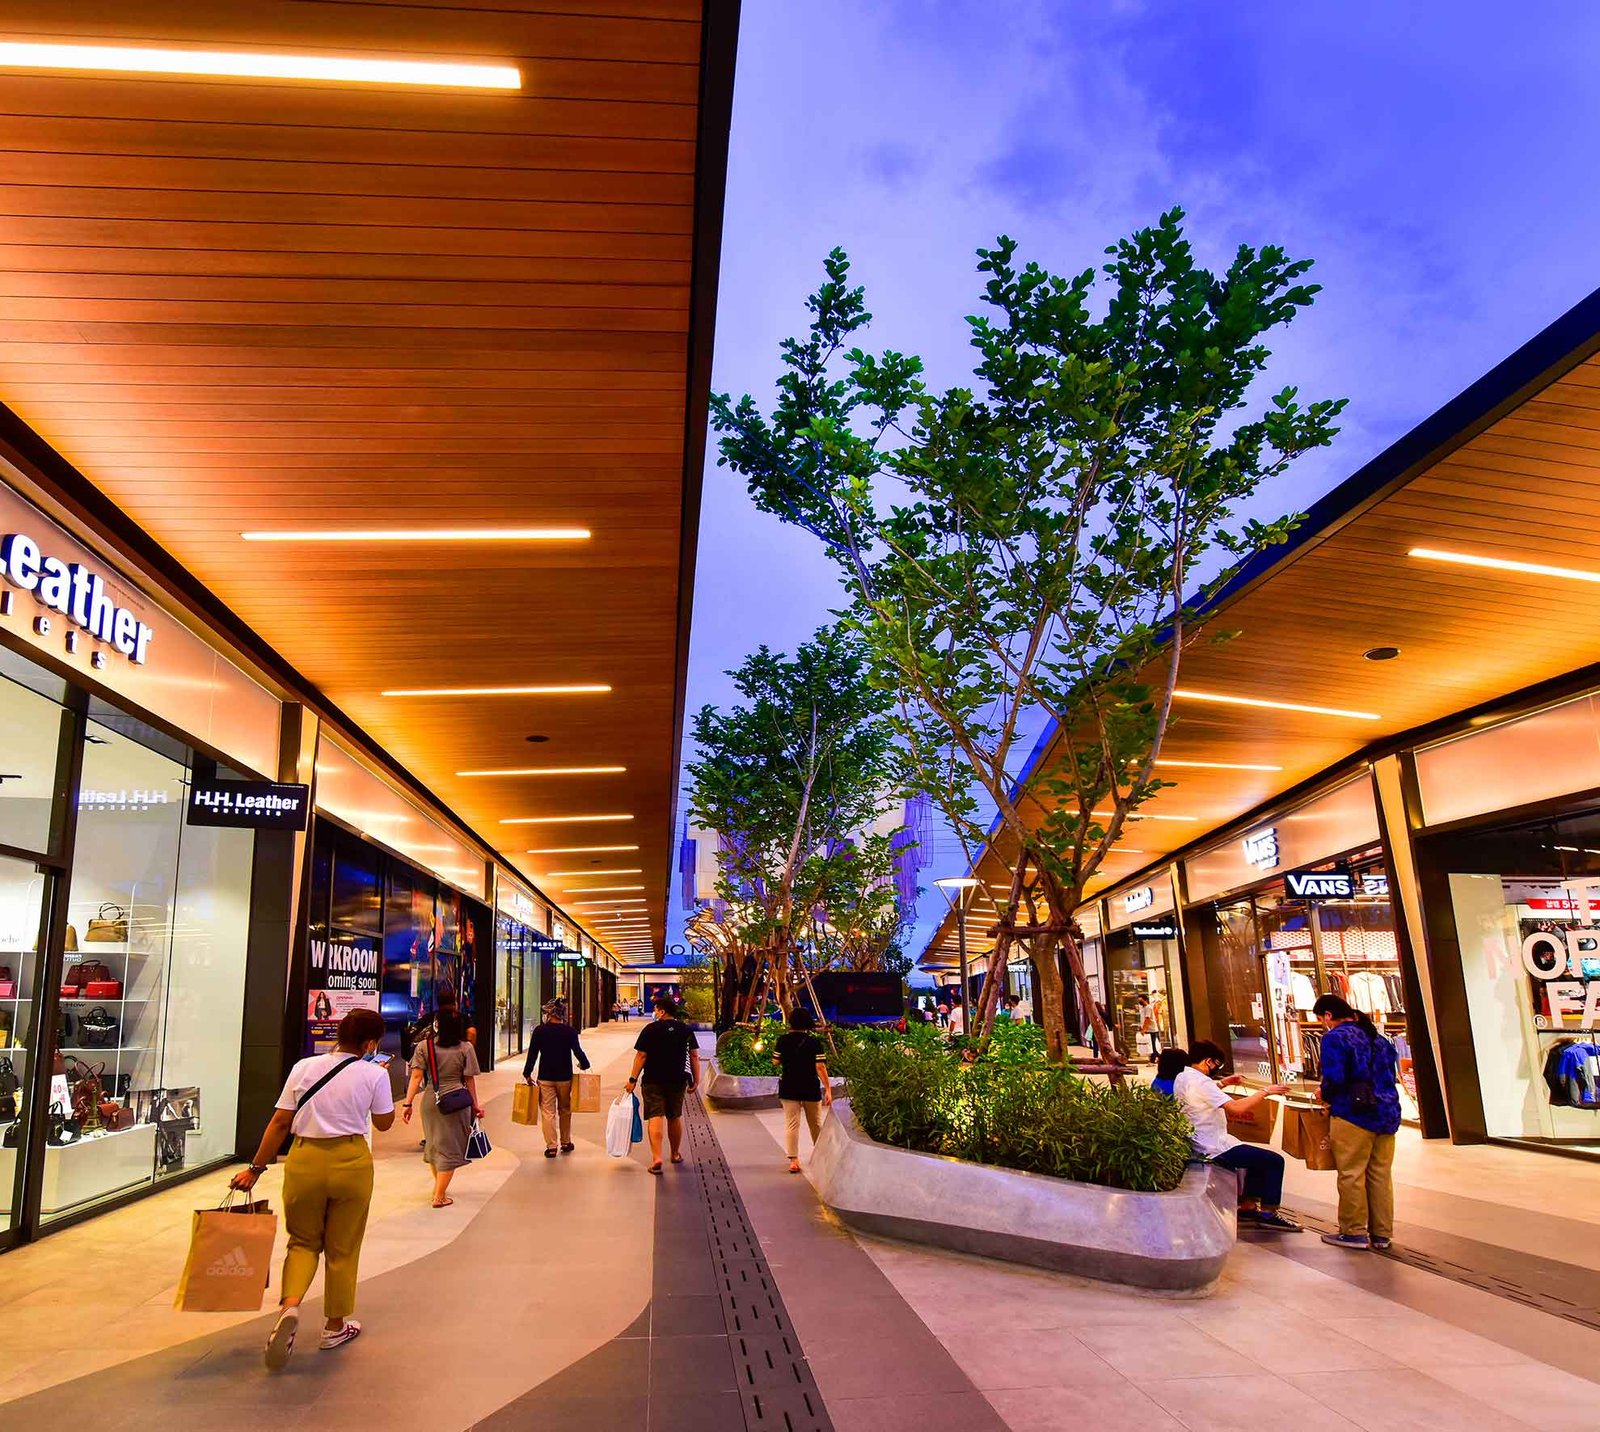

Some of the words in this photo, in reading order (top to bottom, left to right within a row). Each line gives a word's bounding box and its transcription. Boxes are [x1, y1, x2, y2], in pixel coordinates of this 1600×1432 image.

[194, 790, 234, 807] H.H.
[235, 793, 299, 810] Leather
[1287, 875, 1351, 895] VANS
[328, 972, 357, 991] oming
[357, 977, 377, 989] soon
[206, 1267, 254, 1276] adidas
